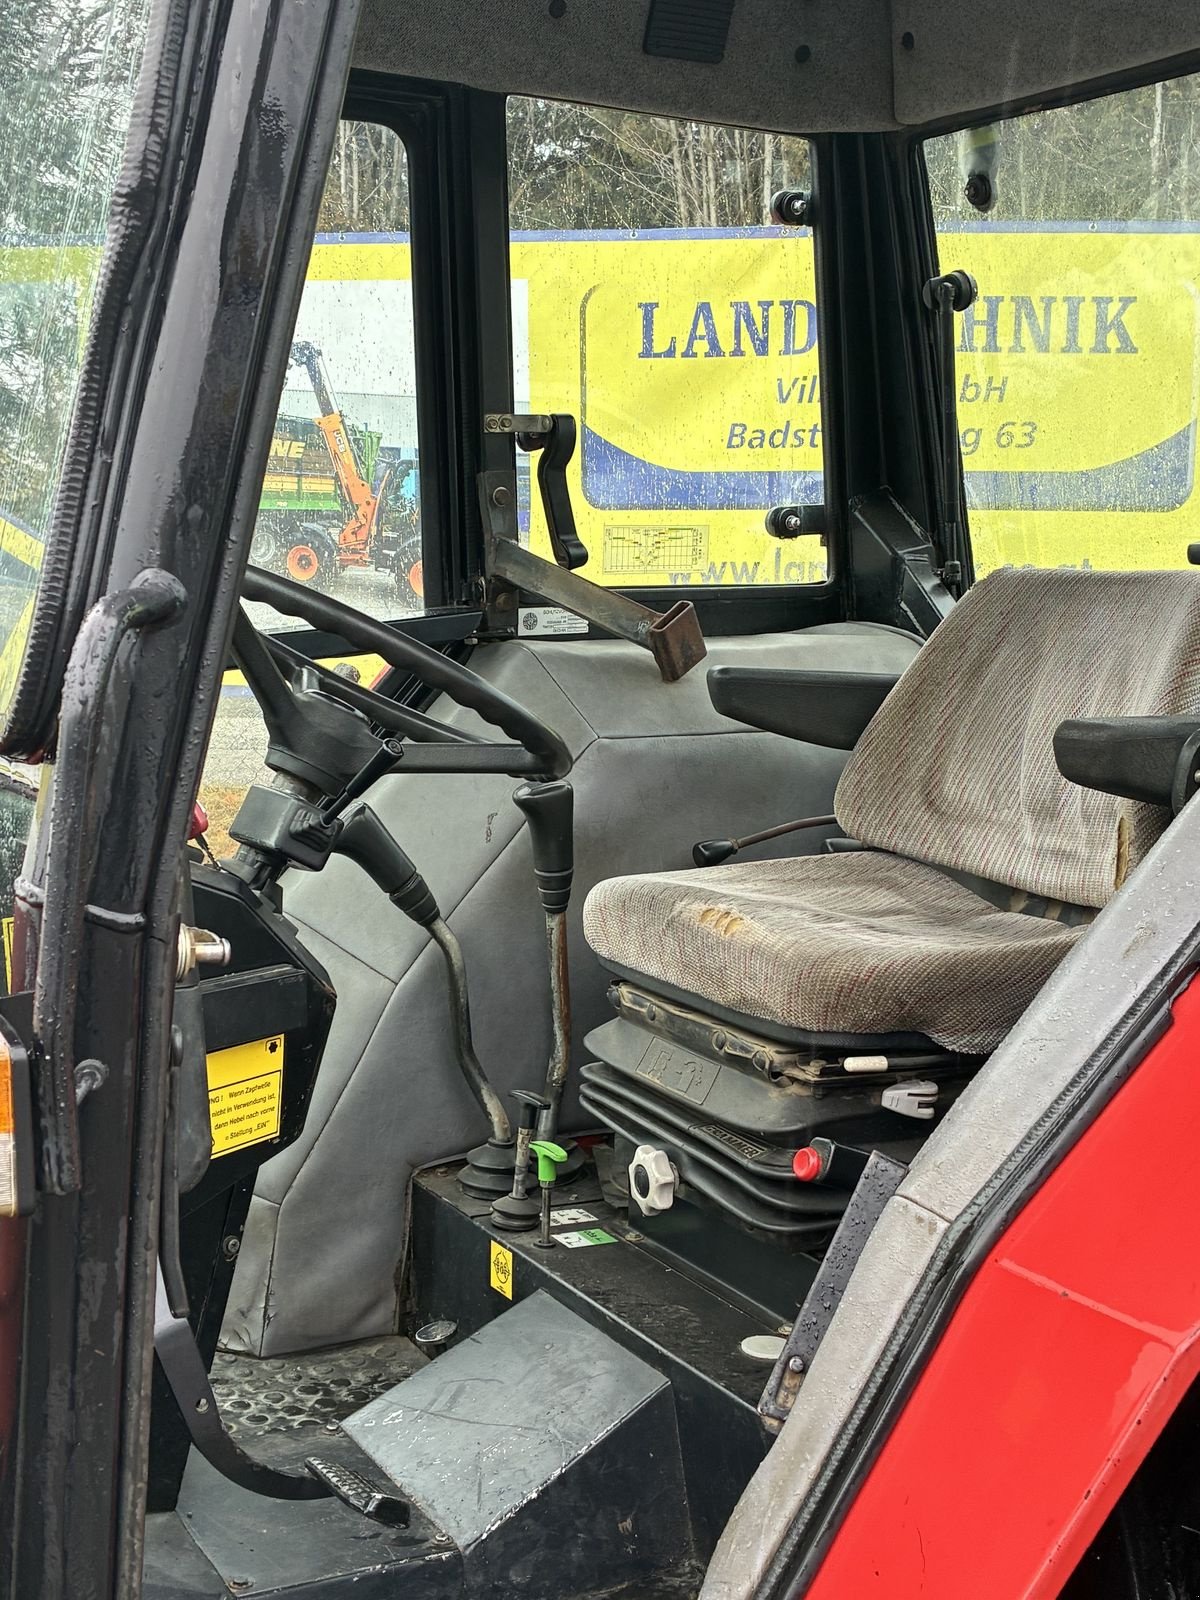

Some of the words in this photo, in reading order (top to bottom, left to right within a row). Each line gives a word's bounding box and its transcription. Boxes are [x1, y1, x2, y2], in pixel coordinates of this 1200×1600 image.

[333, 429, 346, 452] JCB
[995, 421, 1038, 449] 63
[234, 1096, 267, 1111] Verwendung
